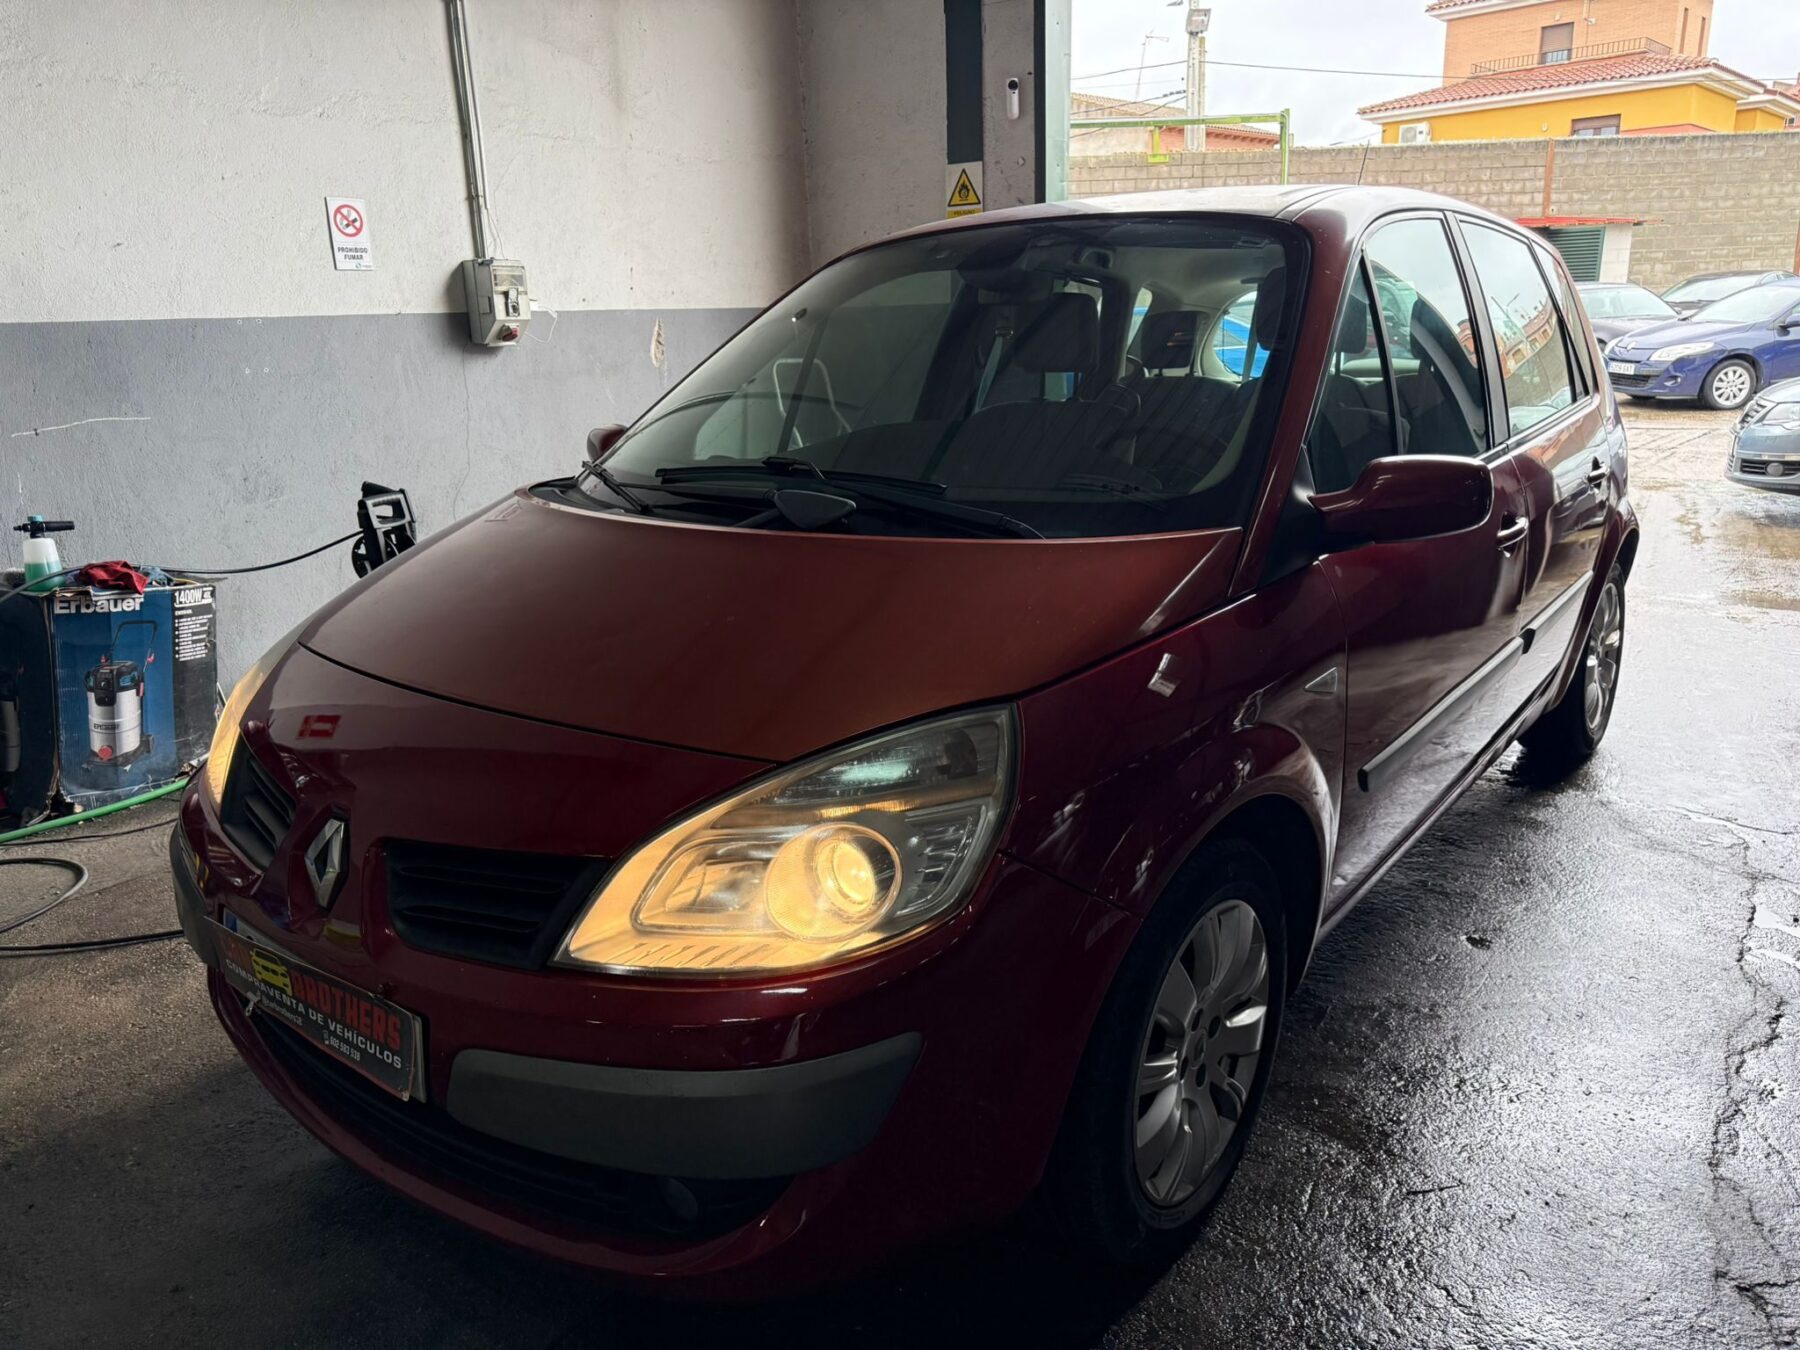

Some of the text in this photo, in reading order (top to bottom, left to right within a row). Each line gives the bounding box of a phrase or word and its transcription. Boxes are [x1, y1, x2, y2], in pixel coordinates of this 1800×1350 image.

[337, 246, 368, 254] PROHIBIDO
[54, 596, 144, 614] Erbauer
[174, 588, 203, 605] 1400W
[291, 970, 401, 1051] BROTHERS
[308, 1008, 325, 1026] DE
[327, 1018, 402, 1070] VEHÍCULOS
